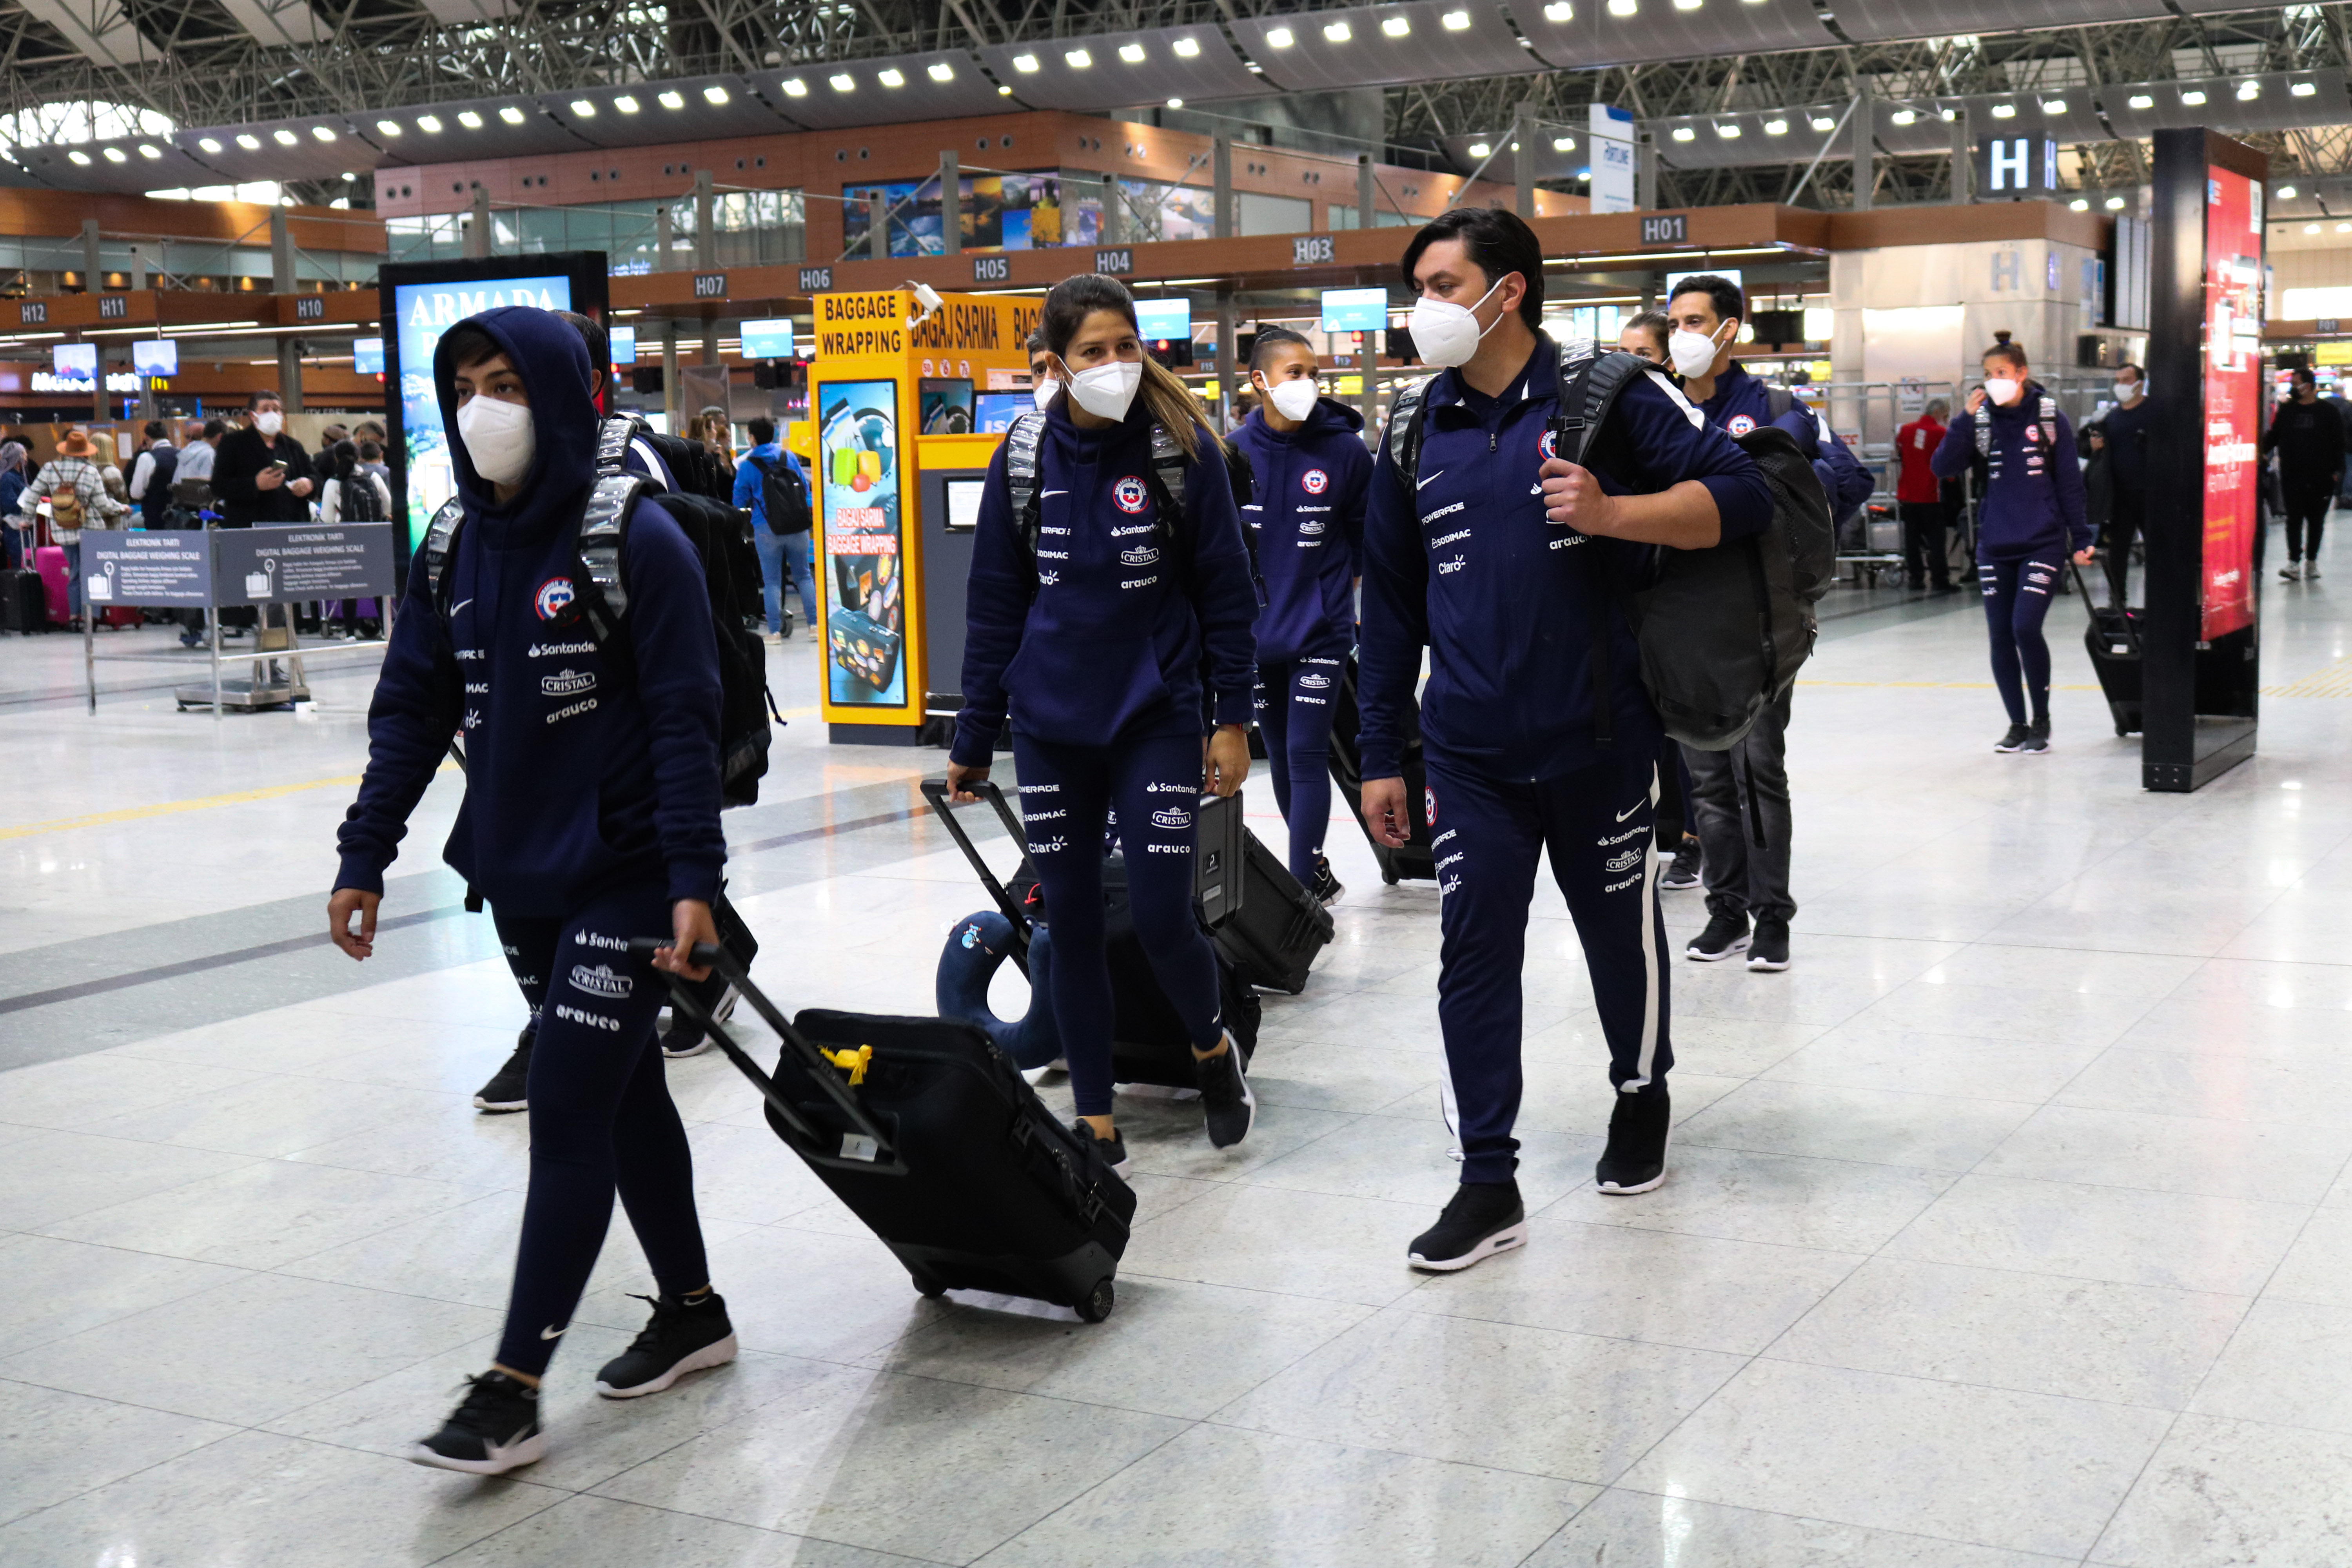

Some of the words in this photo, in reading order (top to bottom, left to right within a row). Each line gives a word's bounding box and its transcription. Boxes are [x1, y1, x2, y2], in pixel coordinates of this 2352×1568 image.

[1991, 139, 2028, 190] H
[2045, 139, 2056, 190] H
[1645, 218, 1682, 240] H01
[1296, 240, 1330, 259] H03
[976, 260, 1007, 279] H05
[1098, 252, 1129, 271] H04
[1991, 252, 2018, 290] H
[696, 276, 724, 295] H07
[801, 269, 830, 289] H06
[22, 304, 45, 323] H12
[101, 298, 124, 316] H11
[298, 299, 321, 316] H10
[826, 296, 895, 320] BAGGAGE
[955, 304, 999, 349] SARMA
[822, 330, 900, 355] WRAPPING
[837, 508, 860, 527] BAGAJ
[860, 508, 885, 527] SARMA
[1421, 502, 1465, 526] POWERADE
[827, 535, 860, 554] BAGGAGE
[860, 535, 897, 554] WRAPPING
[1437, 529, 1471, 546] SODIMAC
[120, 551, 149, 560] BAGGAGE
[149, 551, 180, 560] WEIGHING
[181, 552, 201, 561] SCALE
[282, 546, 312, 556] BAGGAGE
[312, 545, 345, 555] WEIGHING
[346, 544, 365, 553] SCALE
[1124, 553, 1156, 563] CRISTAL
[1439, 557, 1462, 575] Claro
[1121, 575, 1157, 589] arauco
[1308, 657, 1339, 666] Santander
[546, 677, 591, 692] CRISTAL
[1295, 695, 1326, 704] arauco
[547, 698, 598, 724] arauco
[1159, 783, 1197, 794] Santander
[1024, 809, 1067, 822] SODIMAC
[1156, 815, 1189, 825] CRISTAL
[1610, 826, 1650, 846] Santander
[1028, 842, 1061, 854] Claro
[1147, 844, 1190, 854] arauco
[1609, 853, 1641, 869] CRISTAL
[1605, 872, 1642, 893] arauco
[575, 971, 625, 993] CRISTAL
[556, 1004, 621, 1032] arauco
